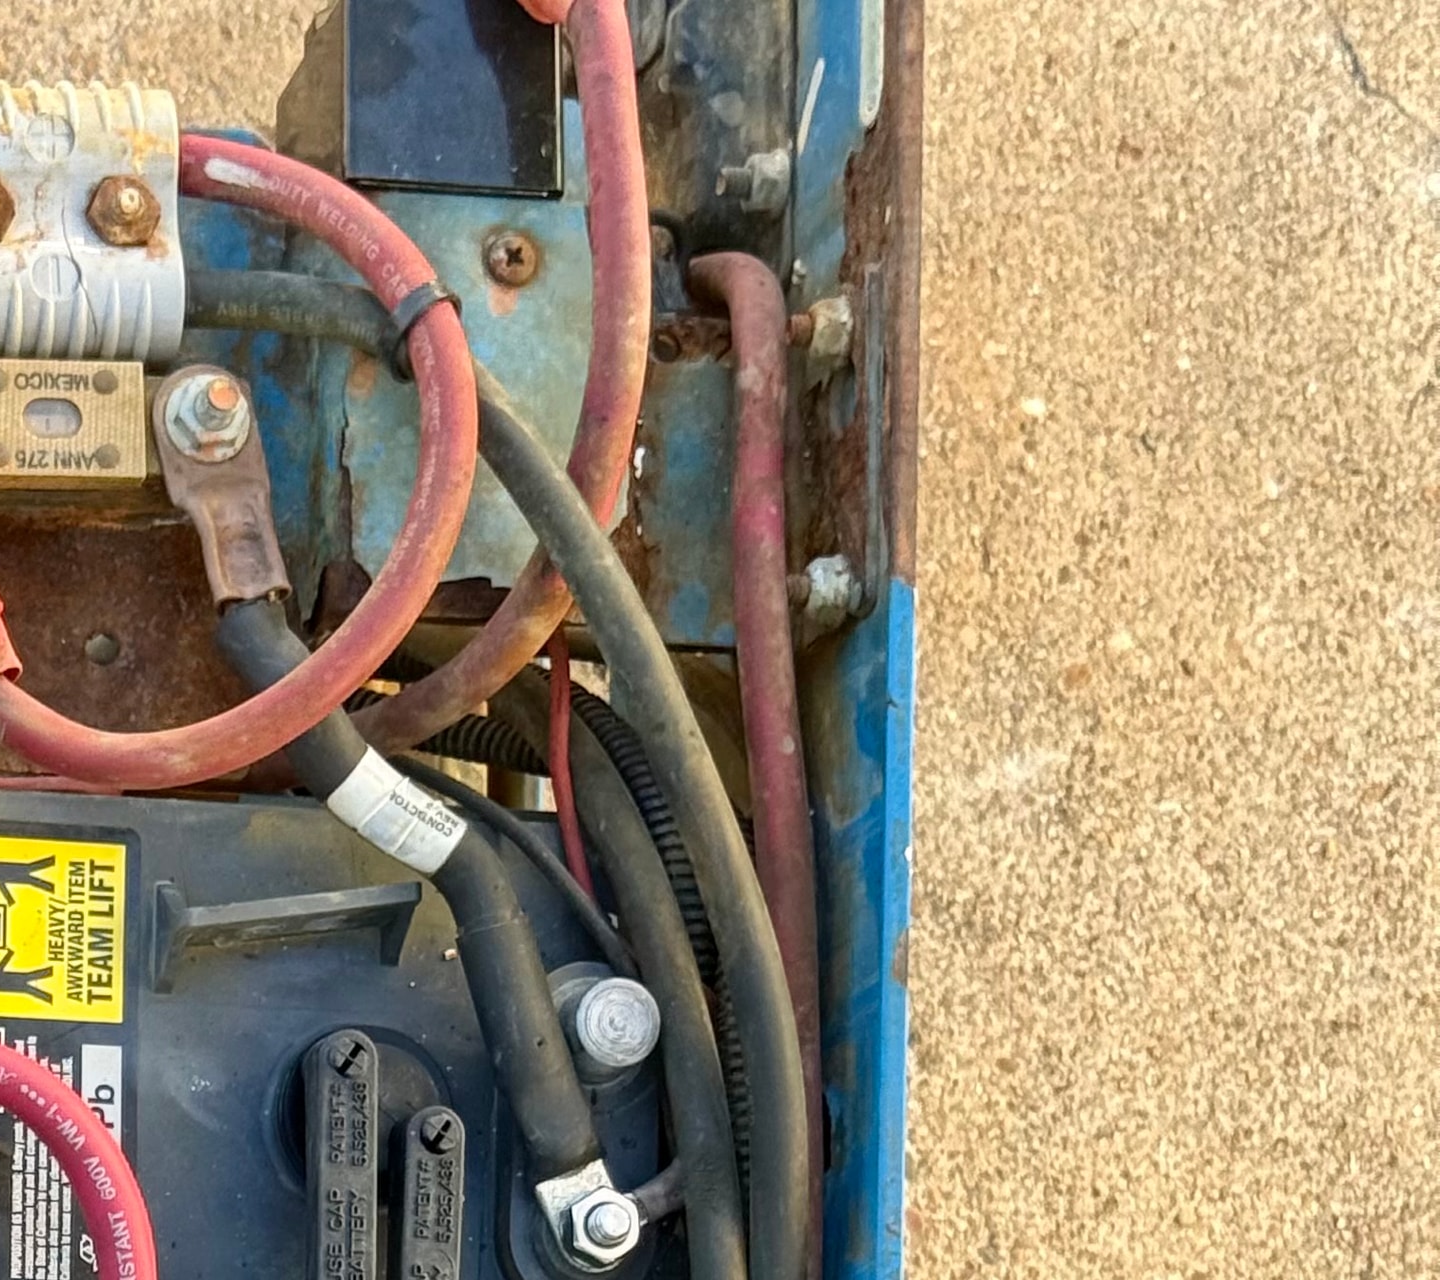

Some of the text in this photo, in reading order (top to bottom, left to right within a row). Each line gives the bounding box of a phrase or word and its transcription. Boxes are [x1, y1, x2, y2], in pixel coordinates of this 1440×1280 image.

[14, 372, 89, 391] MEXICO
[47, 897, 68, 962] HEAVY/
[66, 861, 86, 1003] AWKWARD ITEM
[87, 860, 115, 1006] TEAM LIFT
[45, 1103, 86, 1151] VW-1
[84, 1154, 116, 1200] 600V
